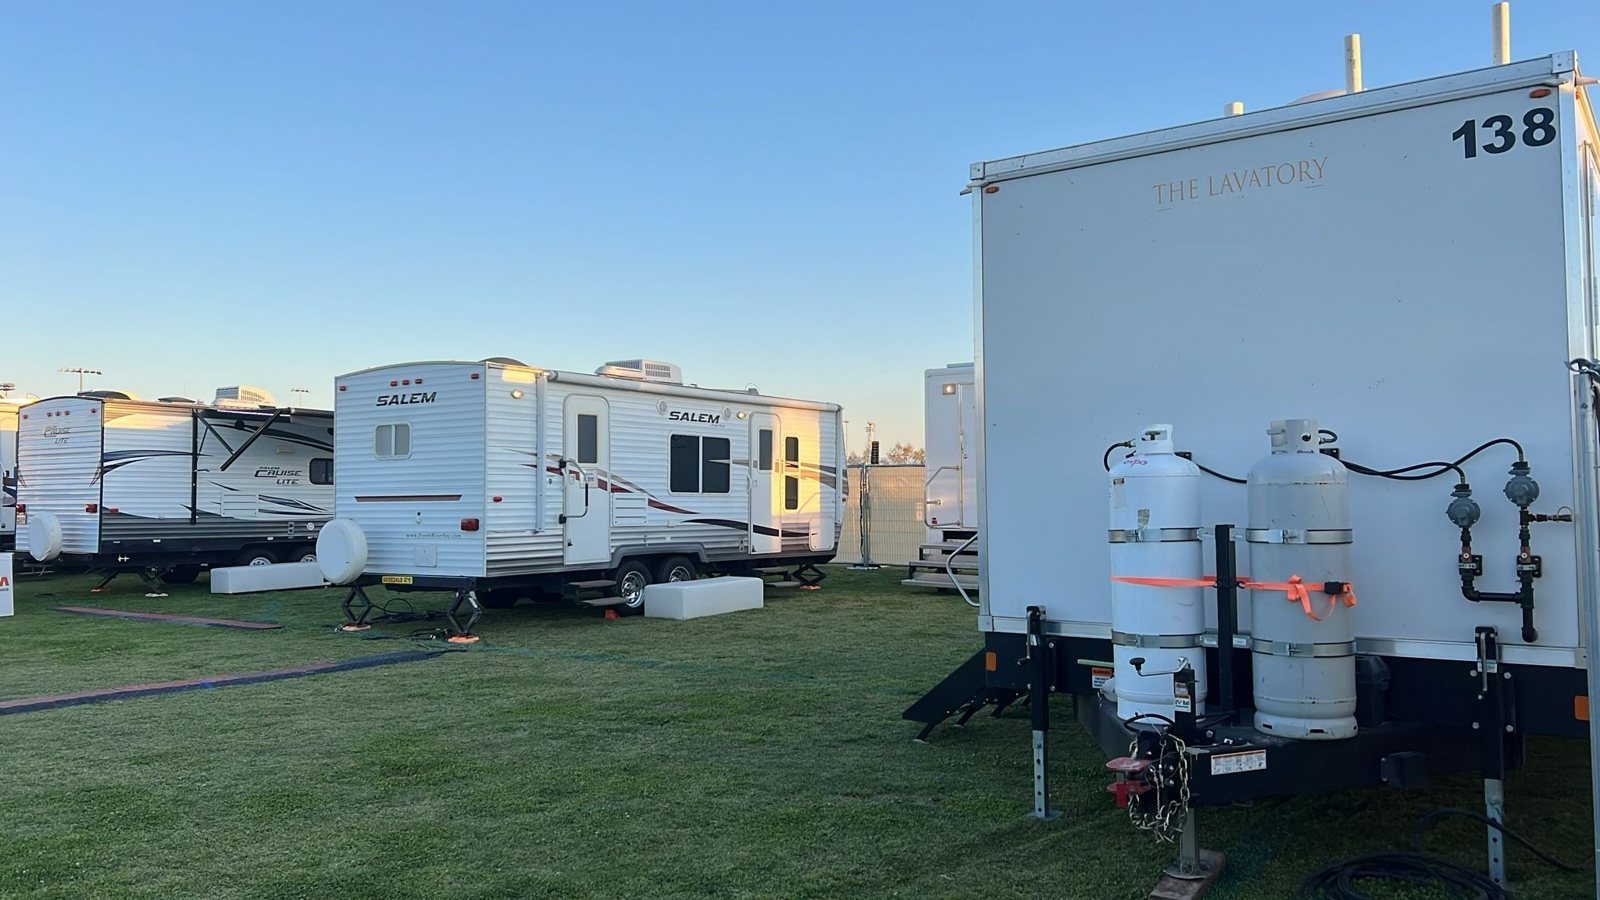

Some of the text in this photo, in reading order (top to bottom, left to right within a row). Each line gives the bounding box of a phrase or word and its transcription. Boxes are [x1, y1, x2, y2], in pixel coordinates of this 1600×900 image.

[1452, 107, 1557, 159] 138
[1152, 156, 1329, 205] THE LAVATORY
[376, 391, 437, 406] SALEM
[668, 411, 720, 424] SALEM
[254, 469, 303, 478] CRUISE
